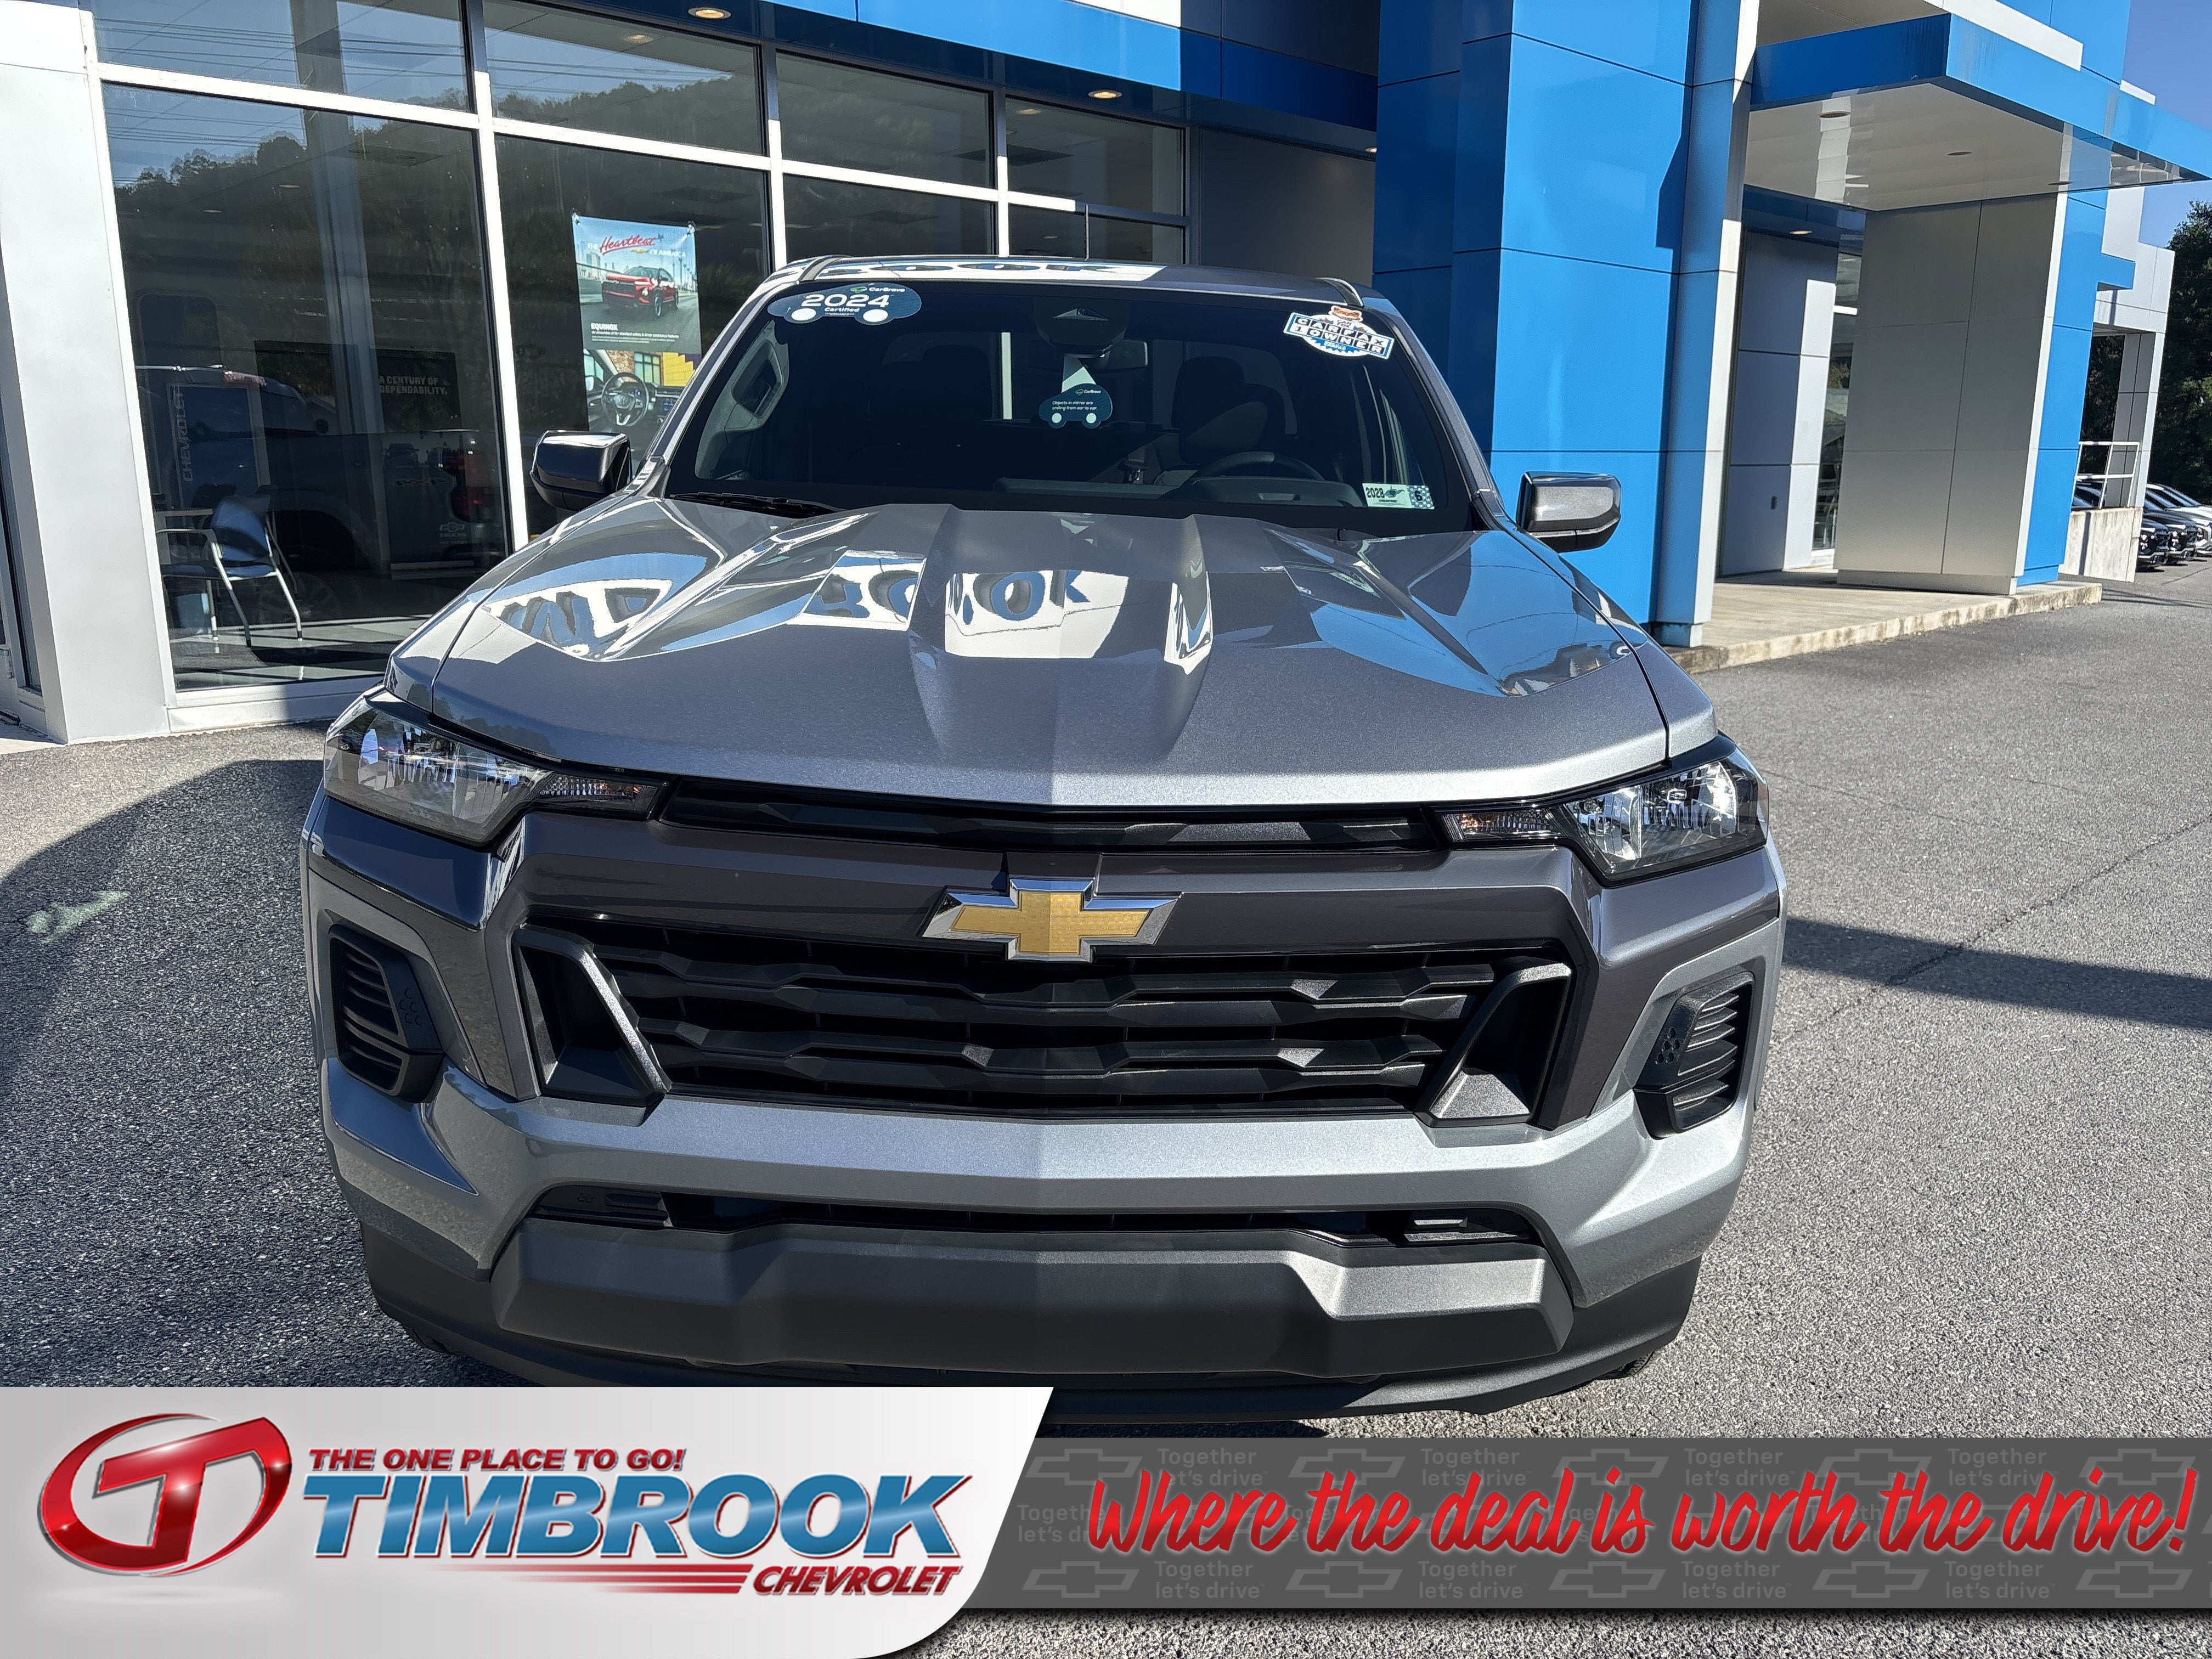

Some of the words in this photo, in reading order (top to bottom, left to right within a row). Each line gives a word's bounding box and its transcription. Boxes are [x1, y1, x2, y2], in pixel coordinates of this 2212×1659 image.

[599, 234, 658, 253] Heartbeat
[801, 294, 890, 308] 2024
[591, 323, 618, 331] EQUINOX
[1297, 318, 1384, 346] CARFAX
[1309, 330, 1383, 354] OWNER
[387, 376, 426, 385] CENTURY
[427, 377, 439, 386] OF
[1365, 487, 1385, 498] 2028
[1414, 490, 1423, 501] 6
